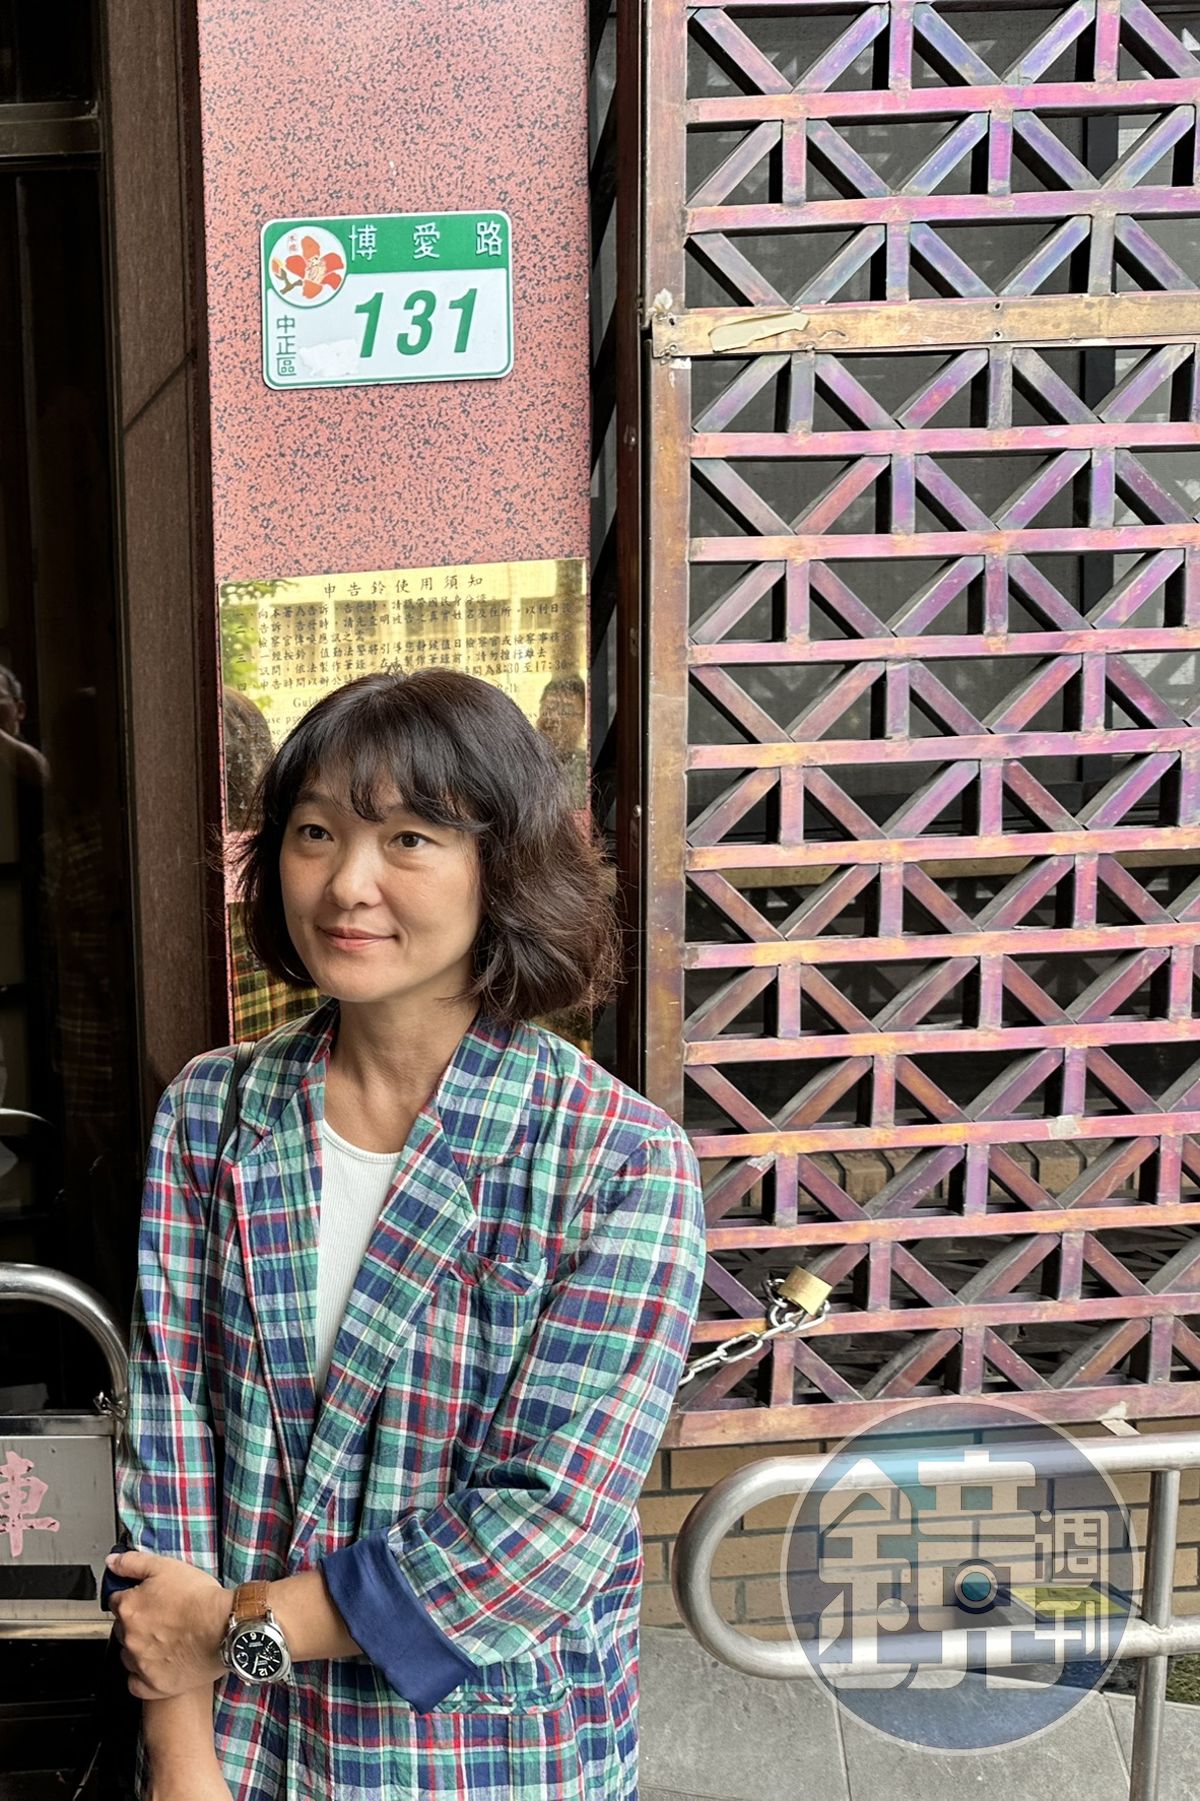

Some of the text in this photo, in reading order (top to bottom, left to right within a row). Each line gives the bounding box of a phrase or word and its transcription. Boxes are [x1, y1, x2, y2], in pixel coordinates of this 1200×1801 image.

[348, 220, 503, 261] 博愛路
[276, 314, 297, 377] 中正區
[354, 288, 478, 358] 131
[323, 574, 484, 599] 申告鈴使用須知
